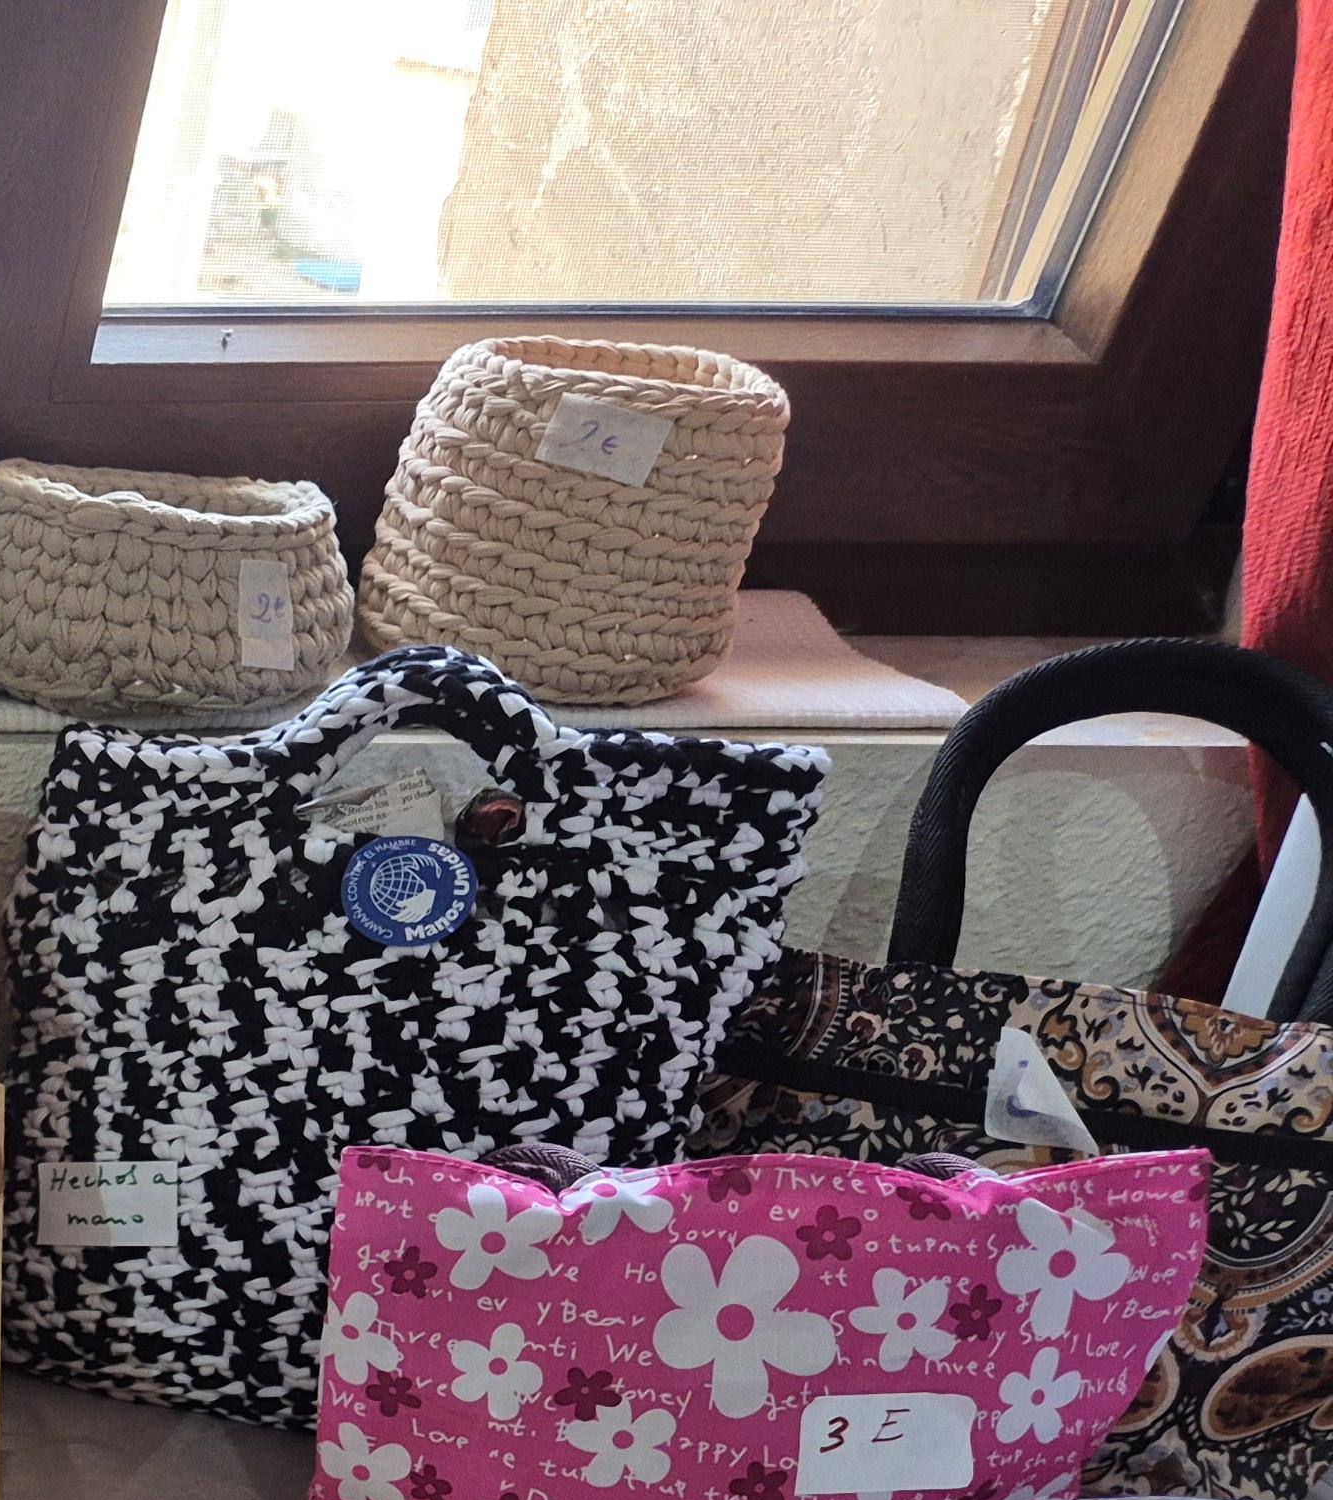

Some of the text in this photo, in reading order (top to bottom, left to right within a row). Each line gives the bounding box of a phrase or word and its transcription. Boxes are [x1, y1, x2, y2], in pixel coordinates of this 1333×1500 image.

[363, 848, 376, 860] EL
[375, 839, 417, 852] HAMBRE
[346, 858, 367, 901] CONTRA
[404, 842, 470, 941] Manos Unidas
[351, 900, 393, 940] CAMPAÑA
[67, 1213, 145, 1226] mano
